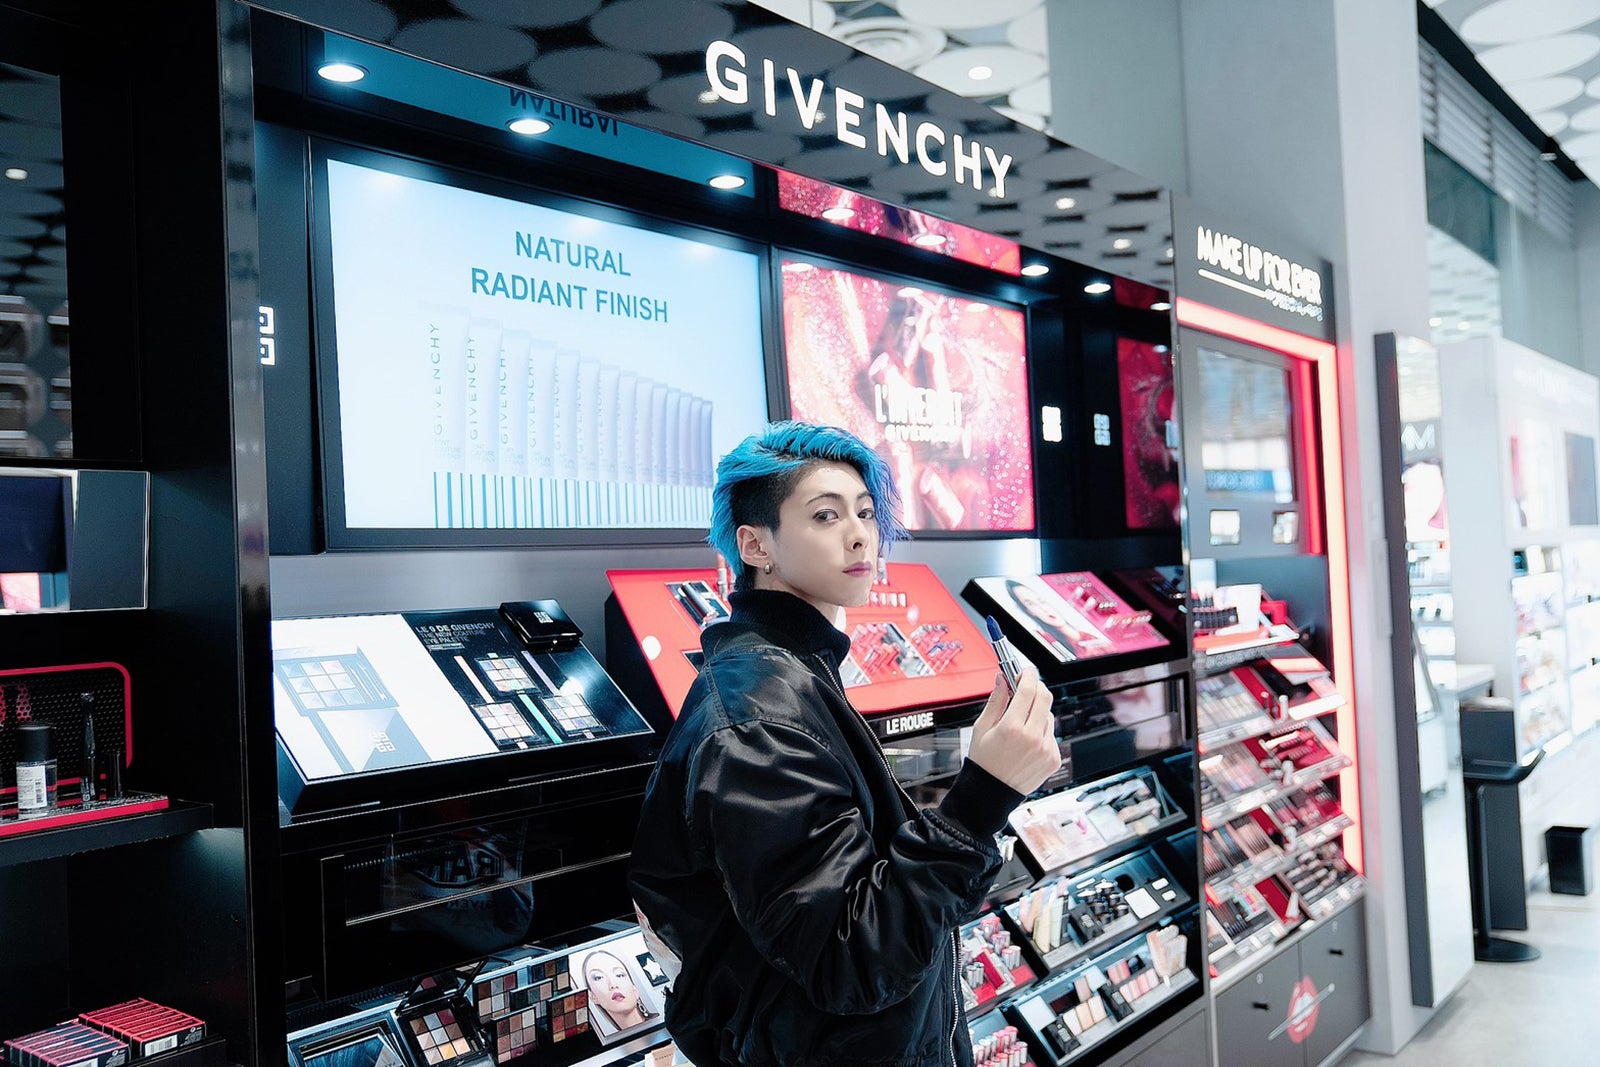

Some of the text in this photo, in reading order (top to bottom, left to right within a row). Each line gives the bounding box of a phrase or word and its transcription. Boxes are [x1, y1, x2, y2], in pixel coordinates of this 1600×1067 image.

[705, 40, 1013, 199] GIVENCHY
[515, 231, 632, 277] NATURAL
[1197, 225, 1244, 276] MAKE
[1243, 242, 1263, 282] UP
[1263, 251, 1292, 295] FOR
[471, 267, 668, 323] RADIANT FINISH
[429, 323, 443, 436] GIVENCHY
[466, 336, 479, 441] GIVENCHY
[436, 624, 451, 632] DE
[451, 622, 495, 631] GIVENCHY
[886, 712, 934, 735] LE ROUGE
